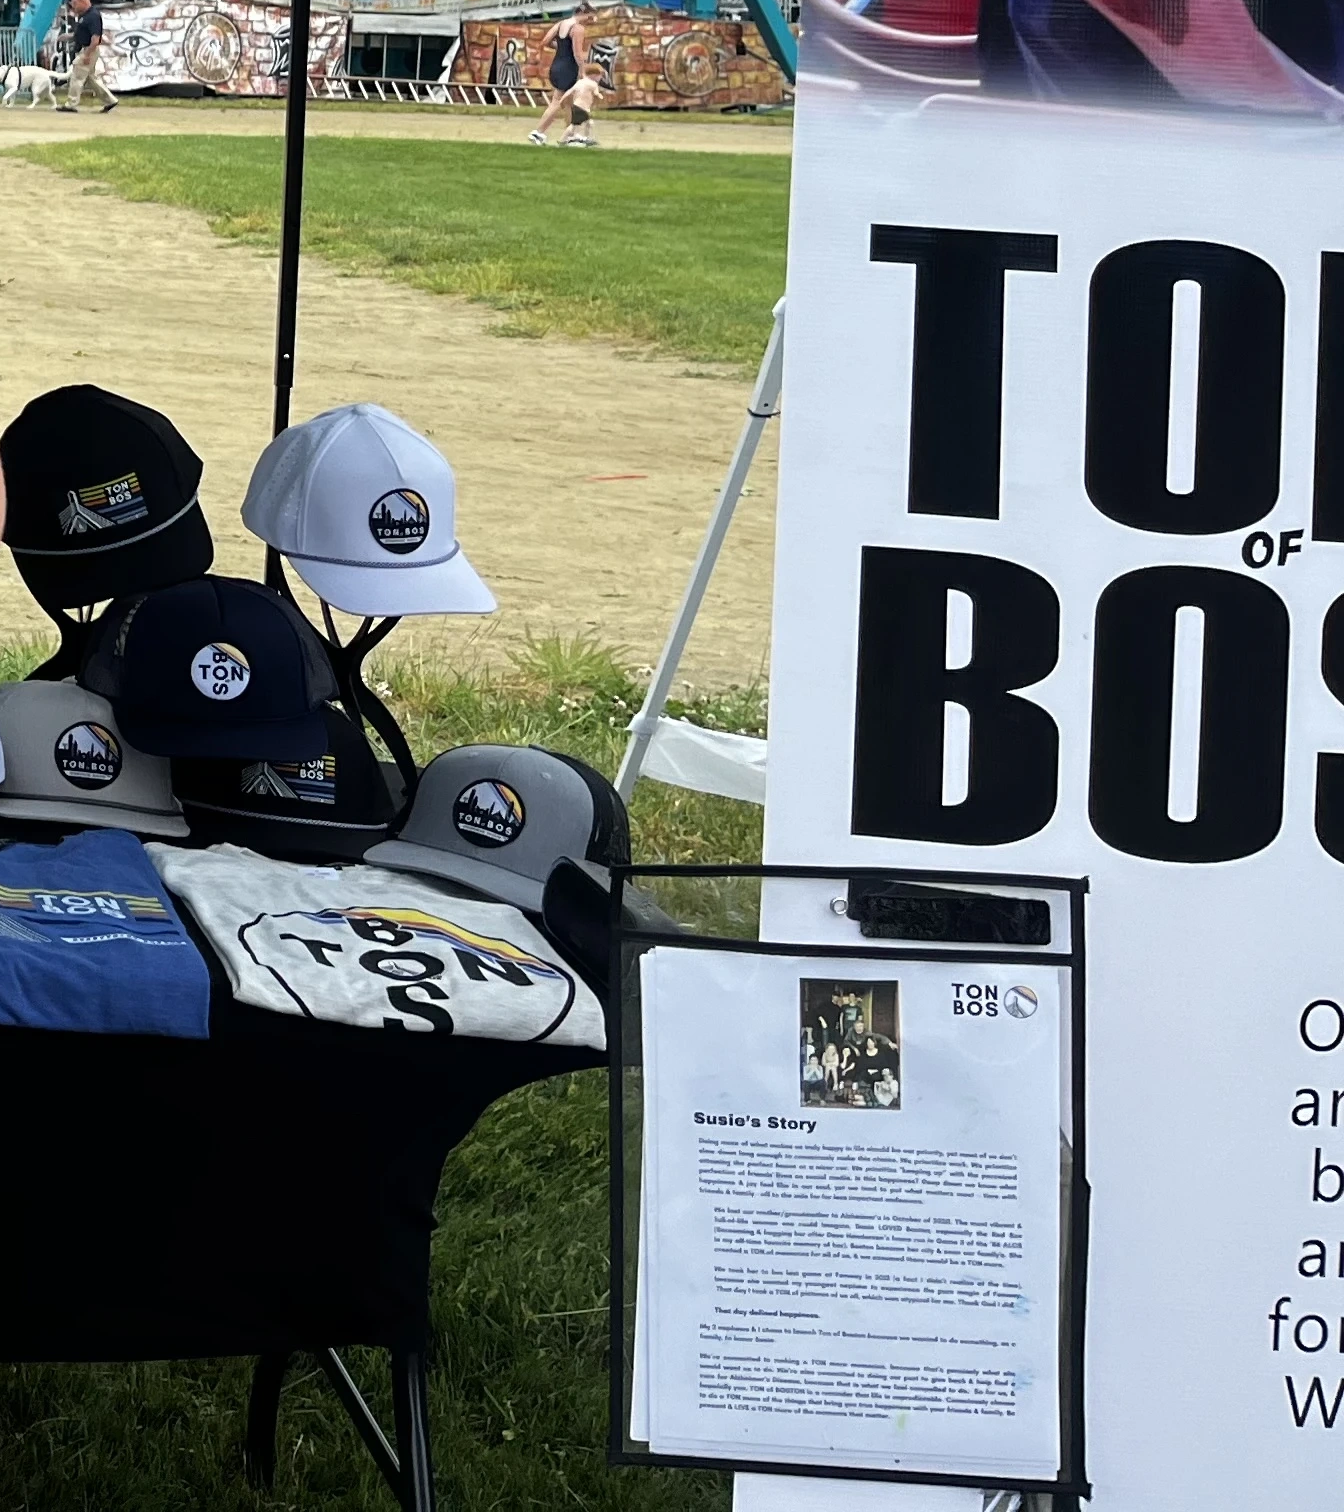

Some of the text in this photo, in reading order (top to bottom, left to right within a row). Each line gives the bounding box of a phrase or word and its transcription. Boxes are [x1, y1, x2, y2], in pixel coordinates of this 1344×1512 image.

[869, 223, 1344, 543] TO
[105, 480, 129, 496] TON
[108, 491, 132, 506] BOS
[376, 526, 425, 537] TON BOS
[1241, 529, 1304, 569] OF
[198, 664, 244, 682] TON
[850, 545, 1344, 864] BO
[62, 759, 114, 773] TON BOS
[301, 759, 325, 770] ON
[299, 769, 324, 781] BOS
[458, 812, 482, 825] TON
[486, 819, 513, 836] BOS
[34, 894, 121, 911] TON
[279, 932, 535, 987] TON
[951, 983, 998, 1001] TON
[953, 999, 999, 1017] BOS
[694, 1112, 817, 1134] Susie's Story
[1268, 1296, 1344, 1353] fo
